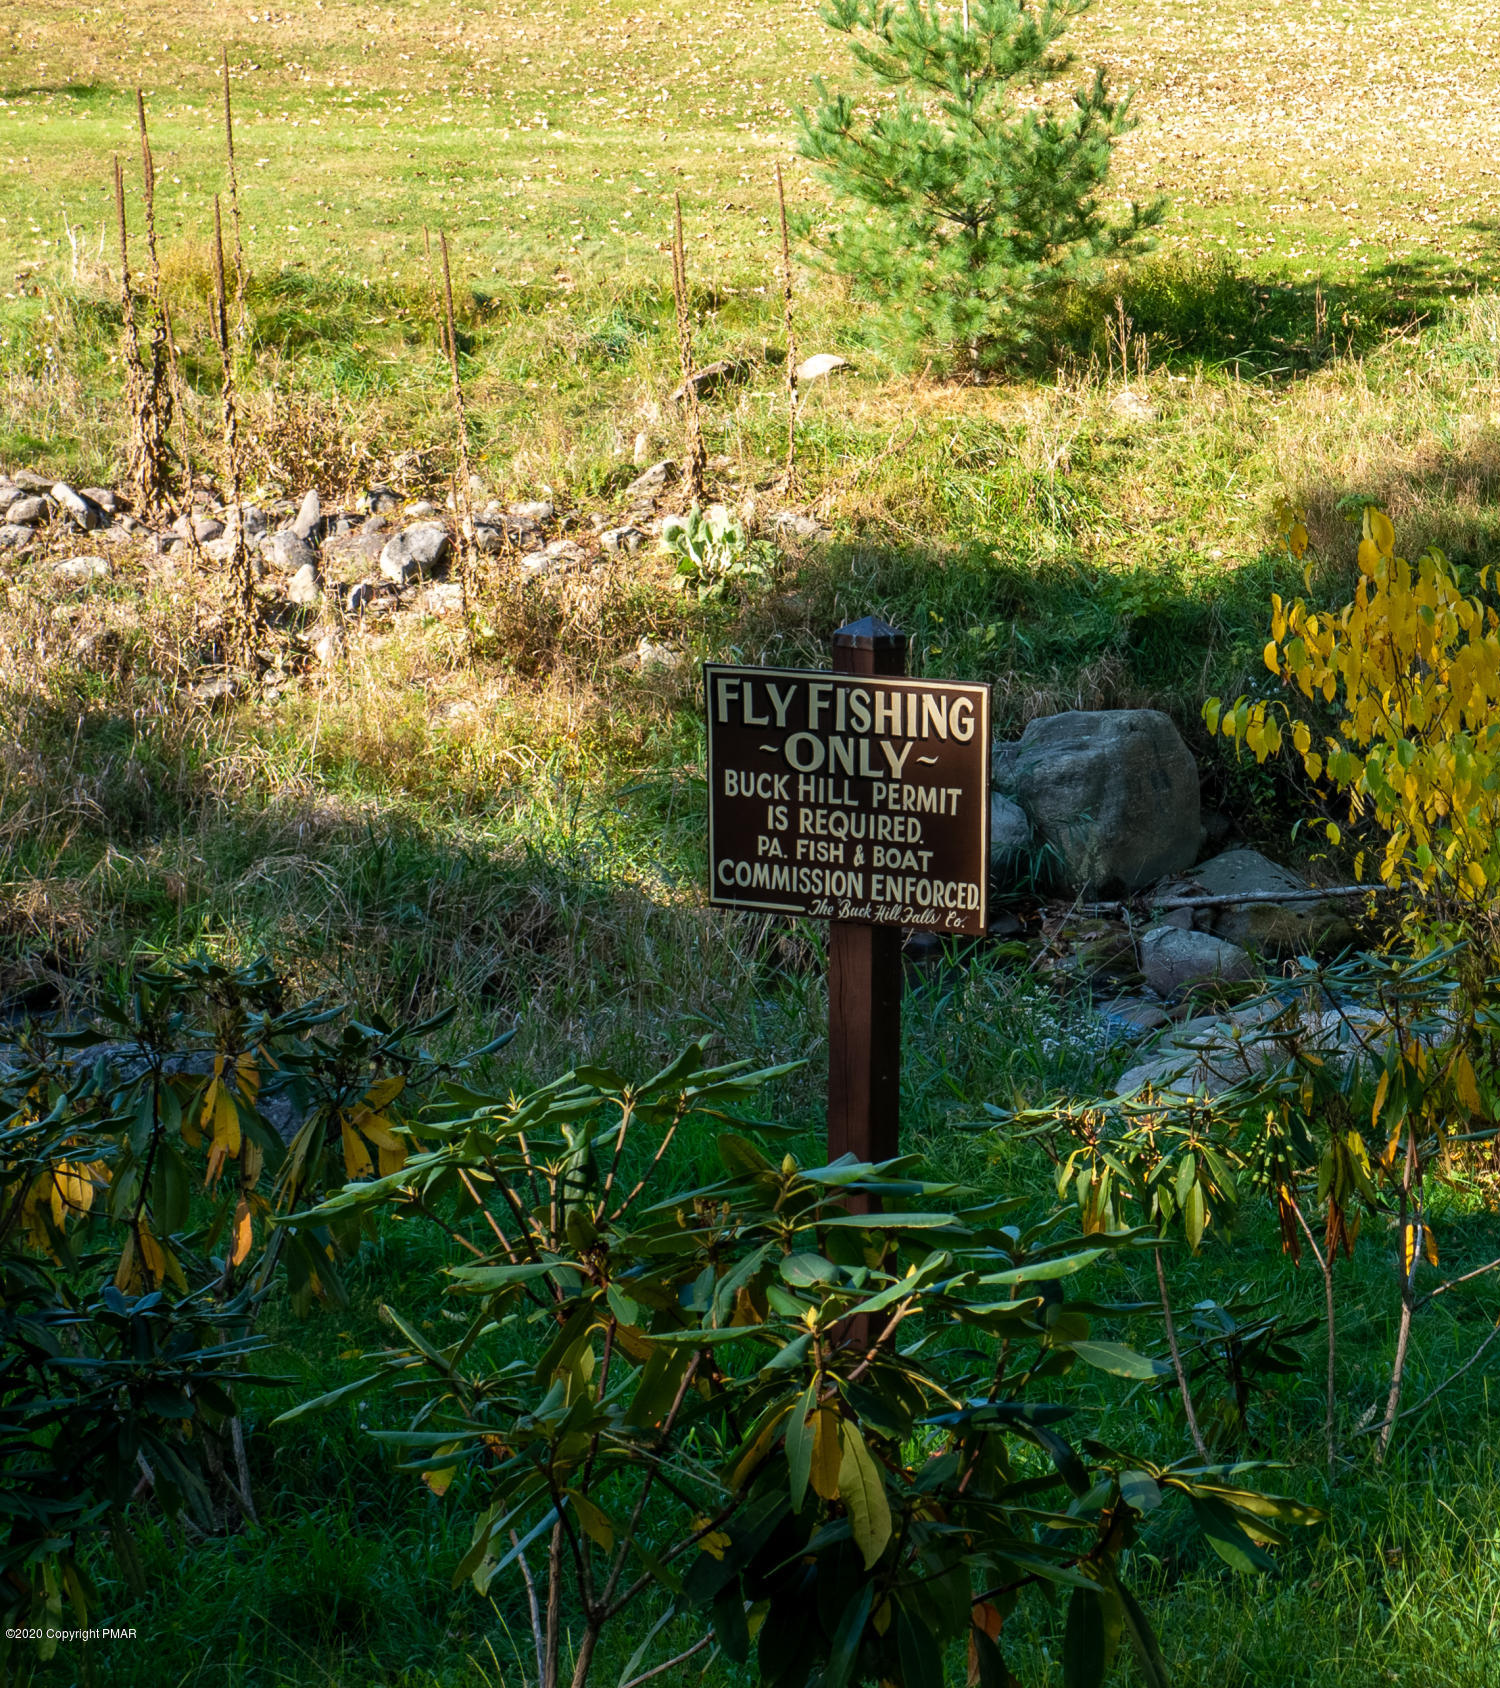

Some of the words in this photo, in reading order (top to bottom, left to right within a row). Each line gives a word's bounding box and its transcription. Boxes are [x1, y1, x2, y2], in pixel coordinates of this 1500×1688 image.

[716, 677, 798, 728] FLY
[808, 682, 976, 743] FISHING
[724, 769, 792, 801] BUCK
[798, 774, 859, 807] HILL
[872, 782, 963, 816] PERMIT
[767, 805, 789, 831] IS
[799, 808, 925, 845] REQUIRED.
[757, 836, 789, 860] PA.
[796, 839, 845, 864] FISH
[853, 844, 867, 867] &
[872, 845, 934, 873] BOAT
[717, 858, 864, 900] COMMISSION
[870, 873, 981, 911] ENFORCED.
[808, 900, 835, 916] The
[837, 898, 872, 920] Buck
[872, 904, 901, 922] Hill
[900, 906, 941, 925] Falls
